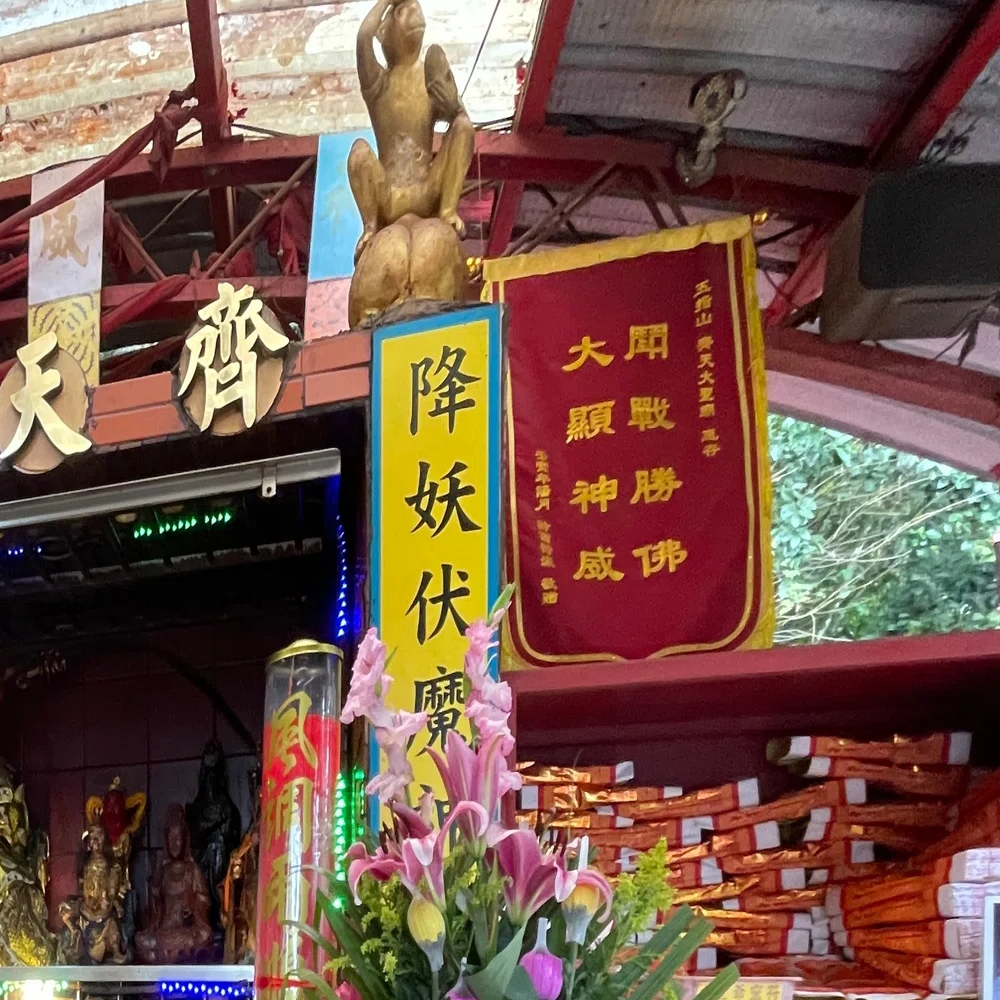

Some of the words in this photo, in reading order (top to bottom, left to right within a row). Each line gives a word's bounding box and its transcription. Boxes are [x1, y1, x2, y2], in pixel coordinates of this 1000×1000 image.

[404, 345, 483, 845] 降妖伏魔
[561, 335, 626, 583] 大顯神威
